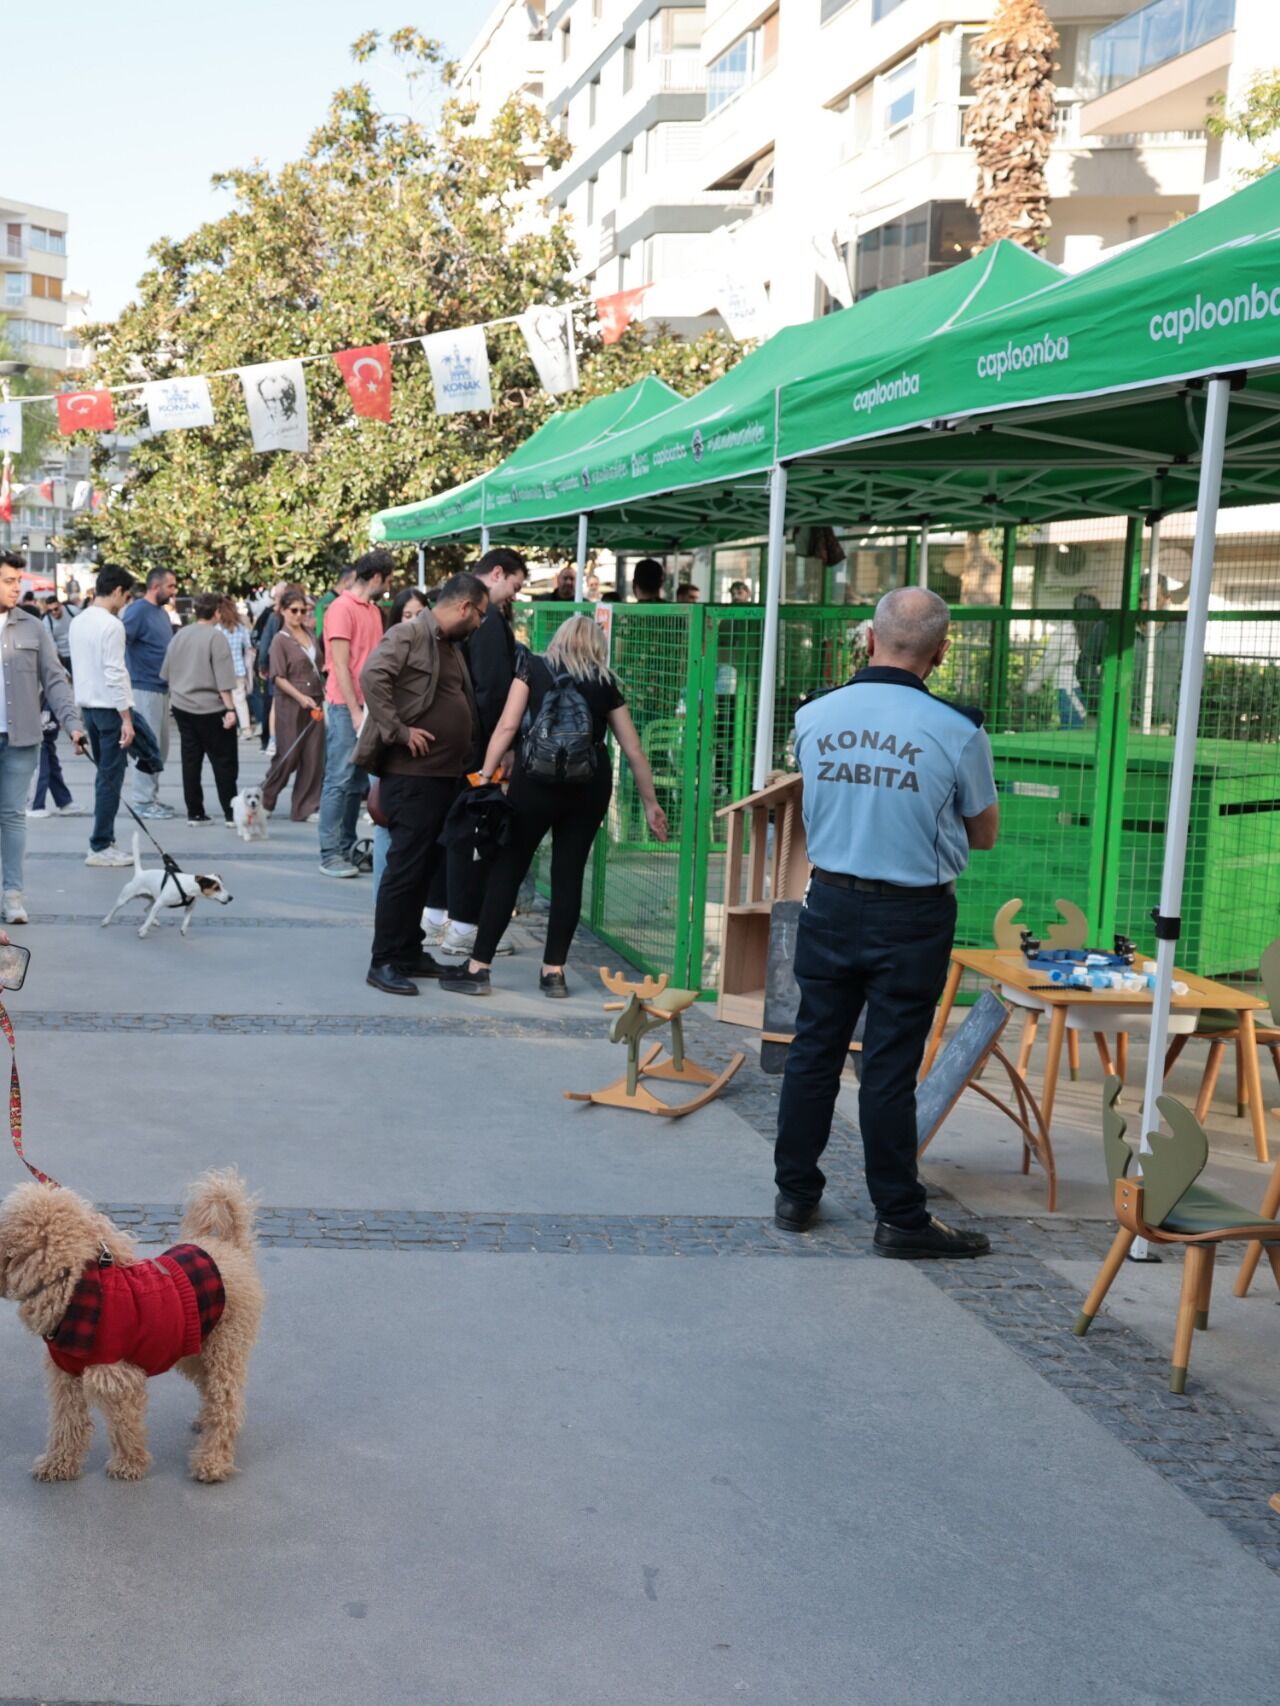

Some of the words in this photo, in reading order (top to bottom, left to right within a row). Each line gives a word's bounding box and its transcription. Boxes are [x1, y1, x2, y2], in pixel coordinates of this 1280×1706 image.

[976, 332, 1069, 382] caploonba
[442, 380, 482, 393] KONAK
[853, 370, 920, 415] caploonba
[817, 729, 925, 767] KONAK
[817, 761, 920, 793] ZABITA
